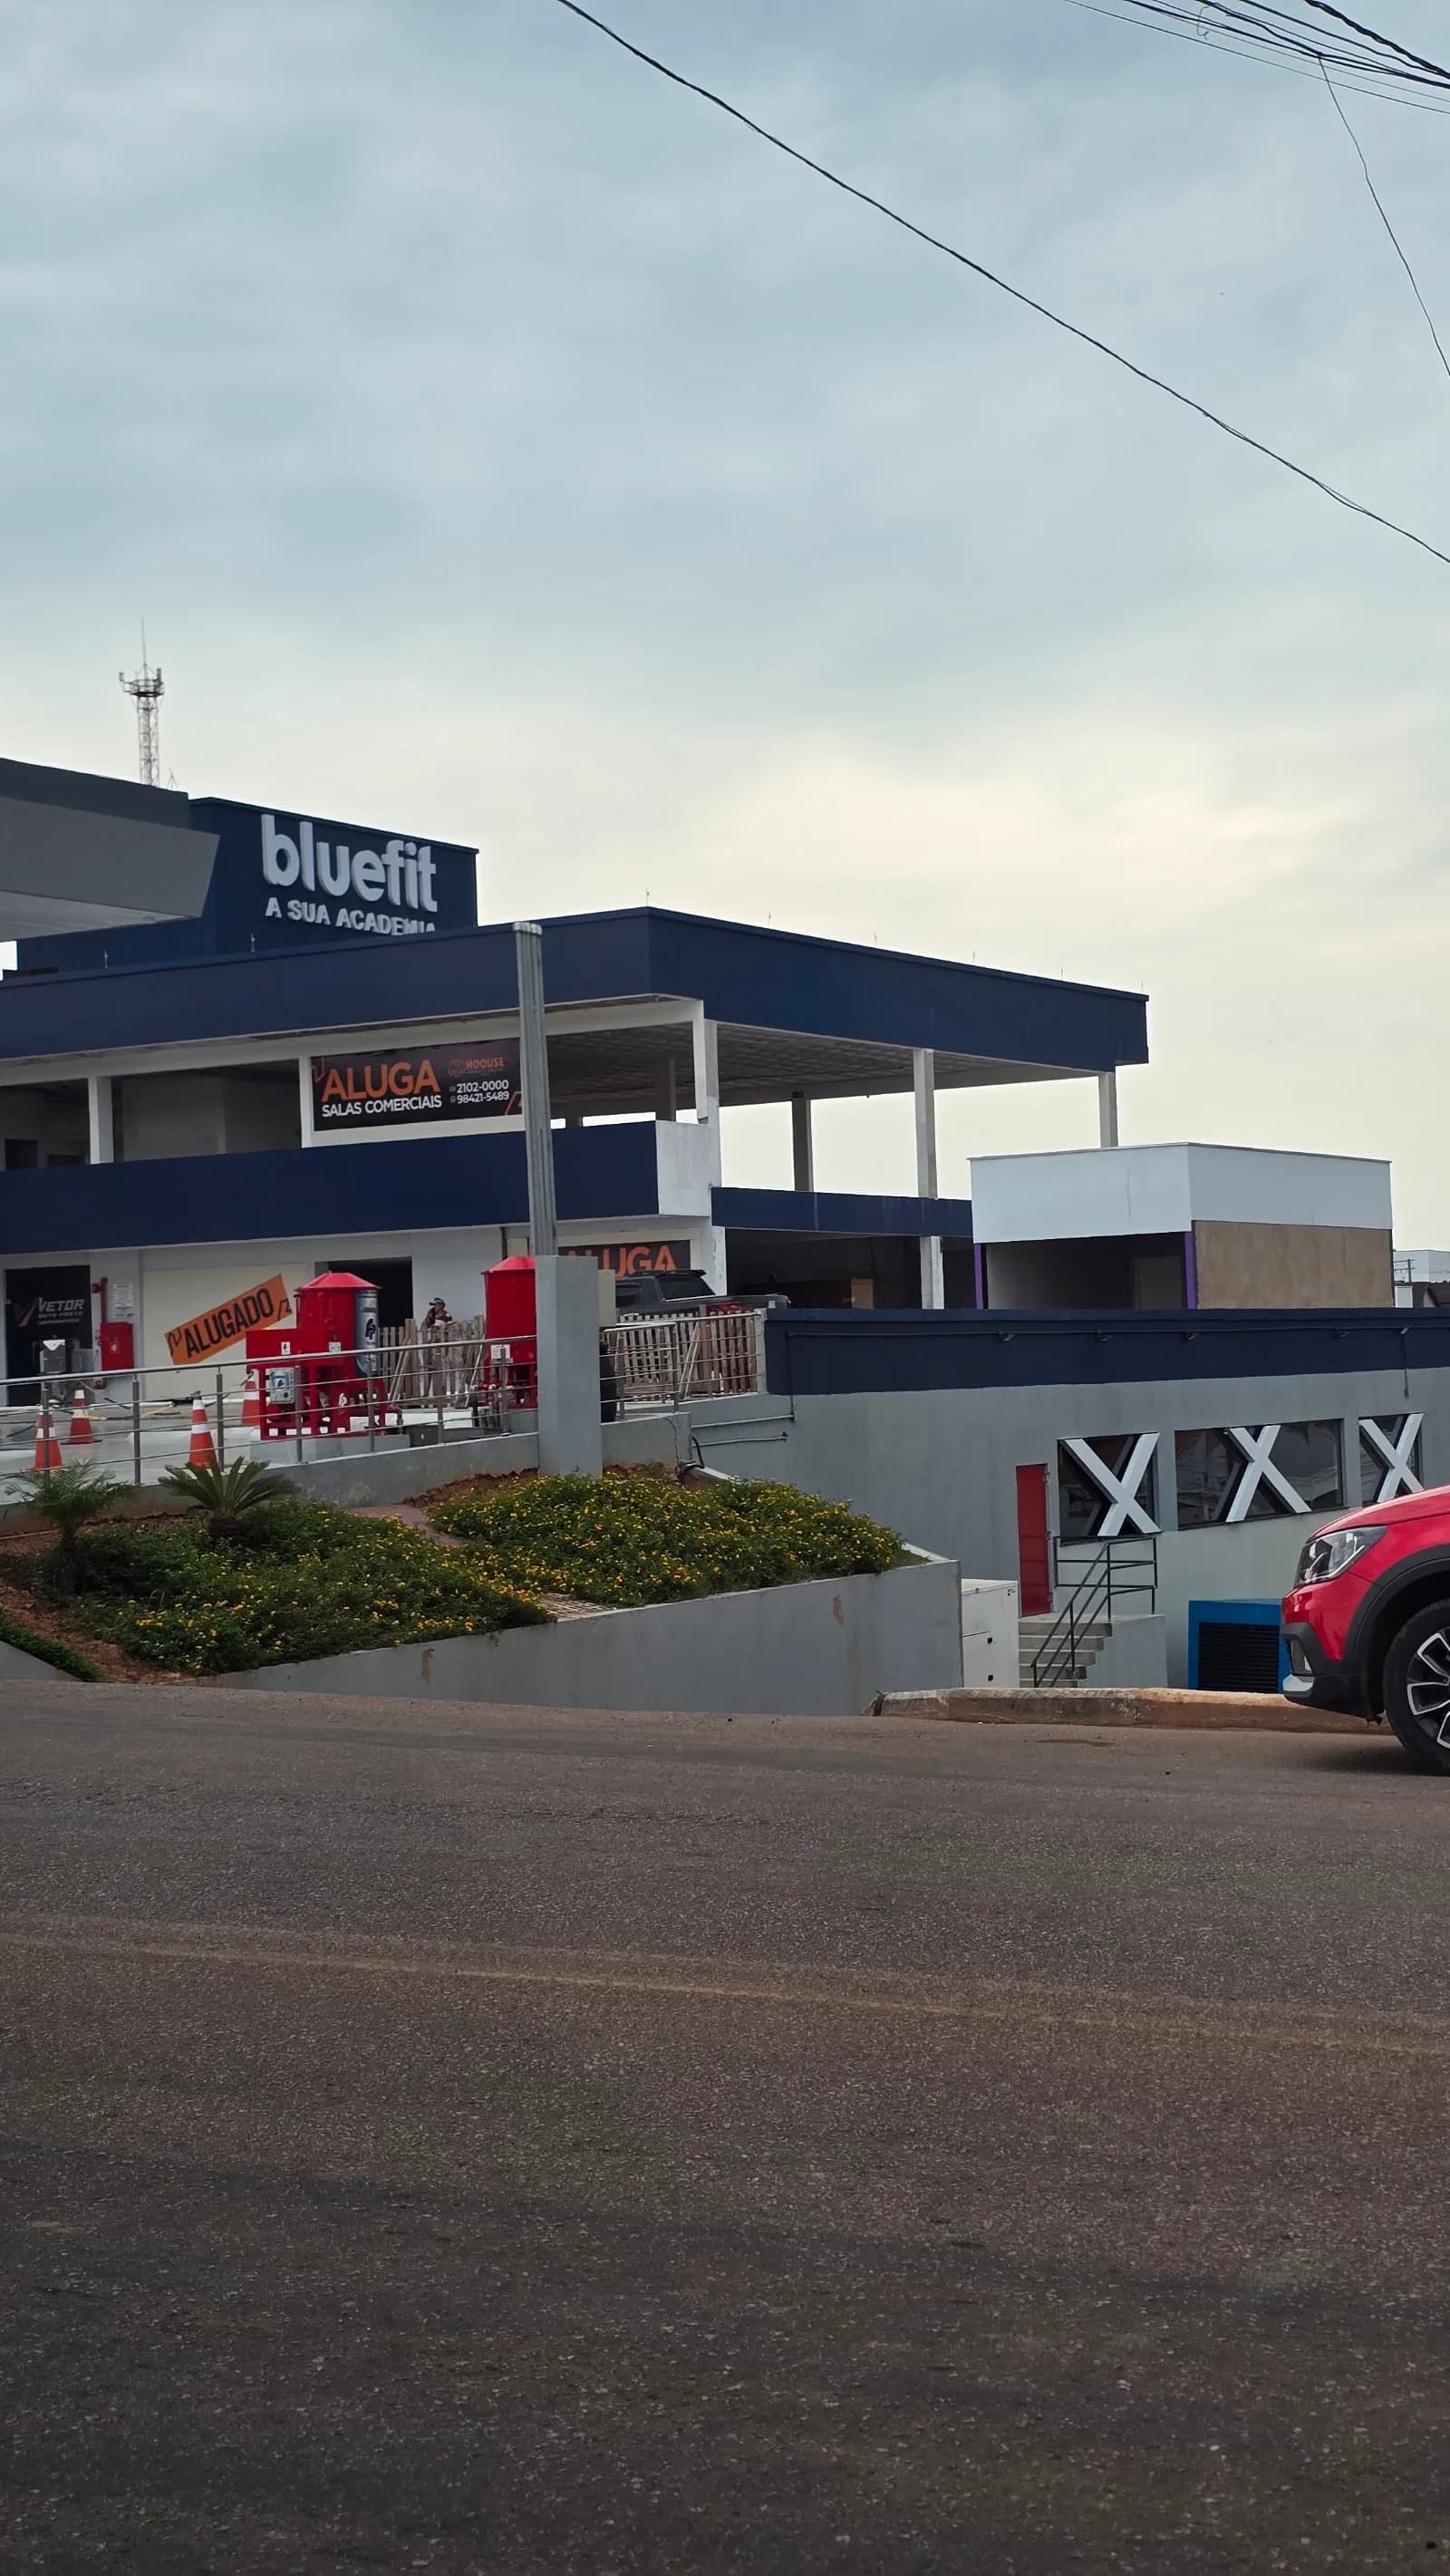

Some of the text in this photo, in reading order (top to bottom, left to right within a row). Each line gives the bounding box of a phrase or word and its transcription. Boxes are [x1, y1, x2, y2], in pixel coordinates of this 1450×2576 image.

[261, 814, 438, 913] bluefit
[265, 897, 282, 918] A
[286, 900, 331, 925] SUA
[321, 1060, 441, 1102] ALUGA
[457, 1080, 509, 1093] 2102-0000
[322, 1095, 442, 1118] SALAS COMERCIAIS
[457, 1091, 509, 1104] 98421-5489
[567, 1245, 677, 1280] UGA
[38, 1297, 84, 1312] VETOR
[183, 1288, 275, 1358] ALUGADO
